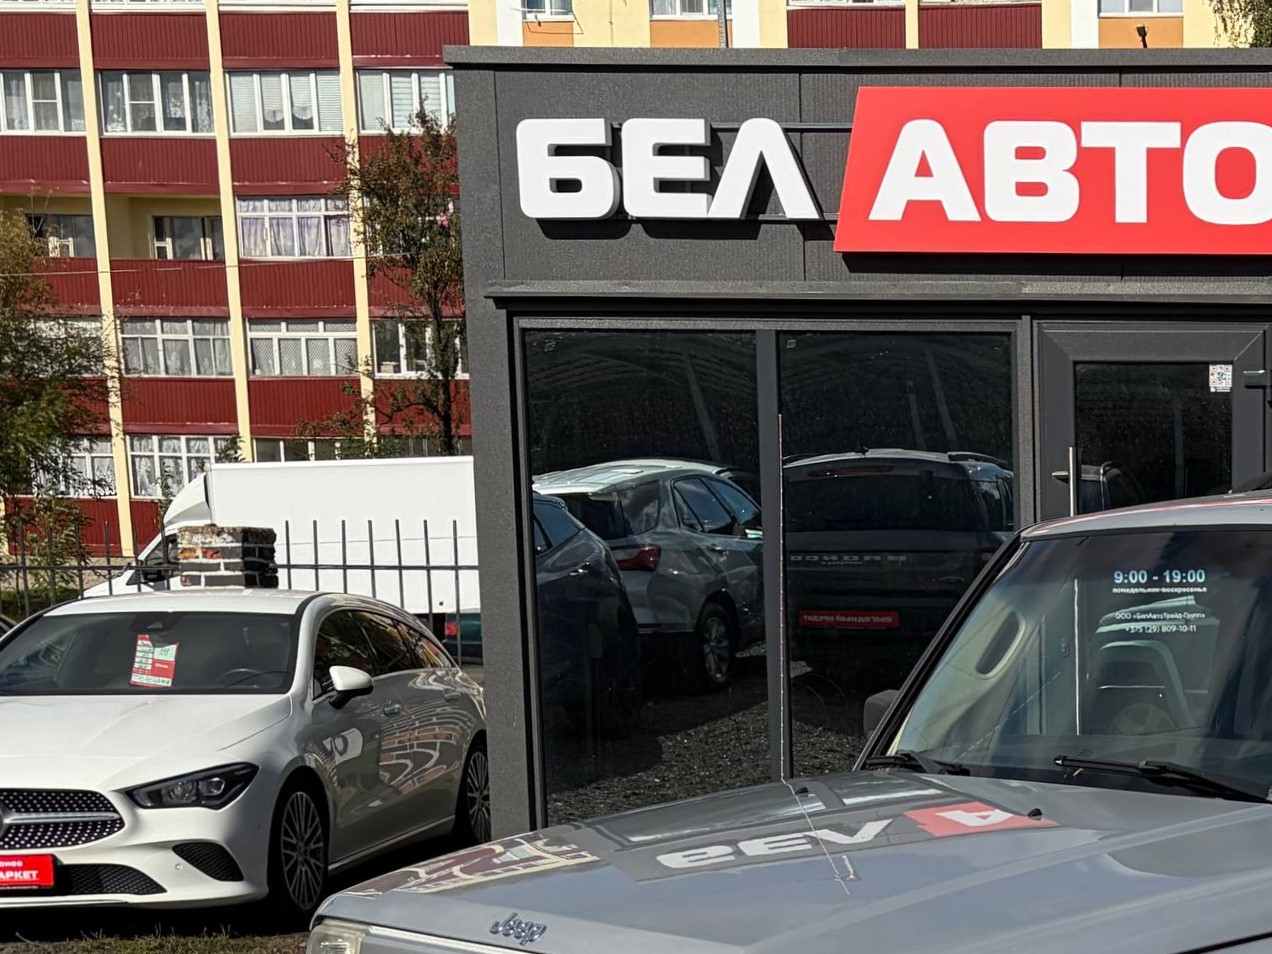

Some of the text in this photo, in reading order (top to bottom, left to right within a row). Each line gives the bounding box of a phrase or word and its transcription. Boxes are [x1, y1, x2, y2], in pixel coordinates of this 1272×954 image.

[516, 117, 822, 219] БЕЛ
[1114, 570, 1148, 584] 9:00
[1163, 569, 1206, 583] 19:00
[1115, 612, 1132, 620] ООО
[1145, 625, 1160, 634] (29)
[1161, 624, 1197, 633] 809-10-11
[489, 912, 547, 947] Jeep
